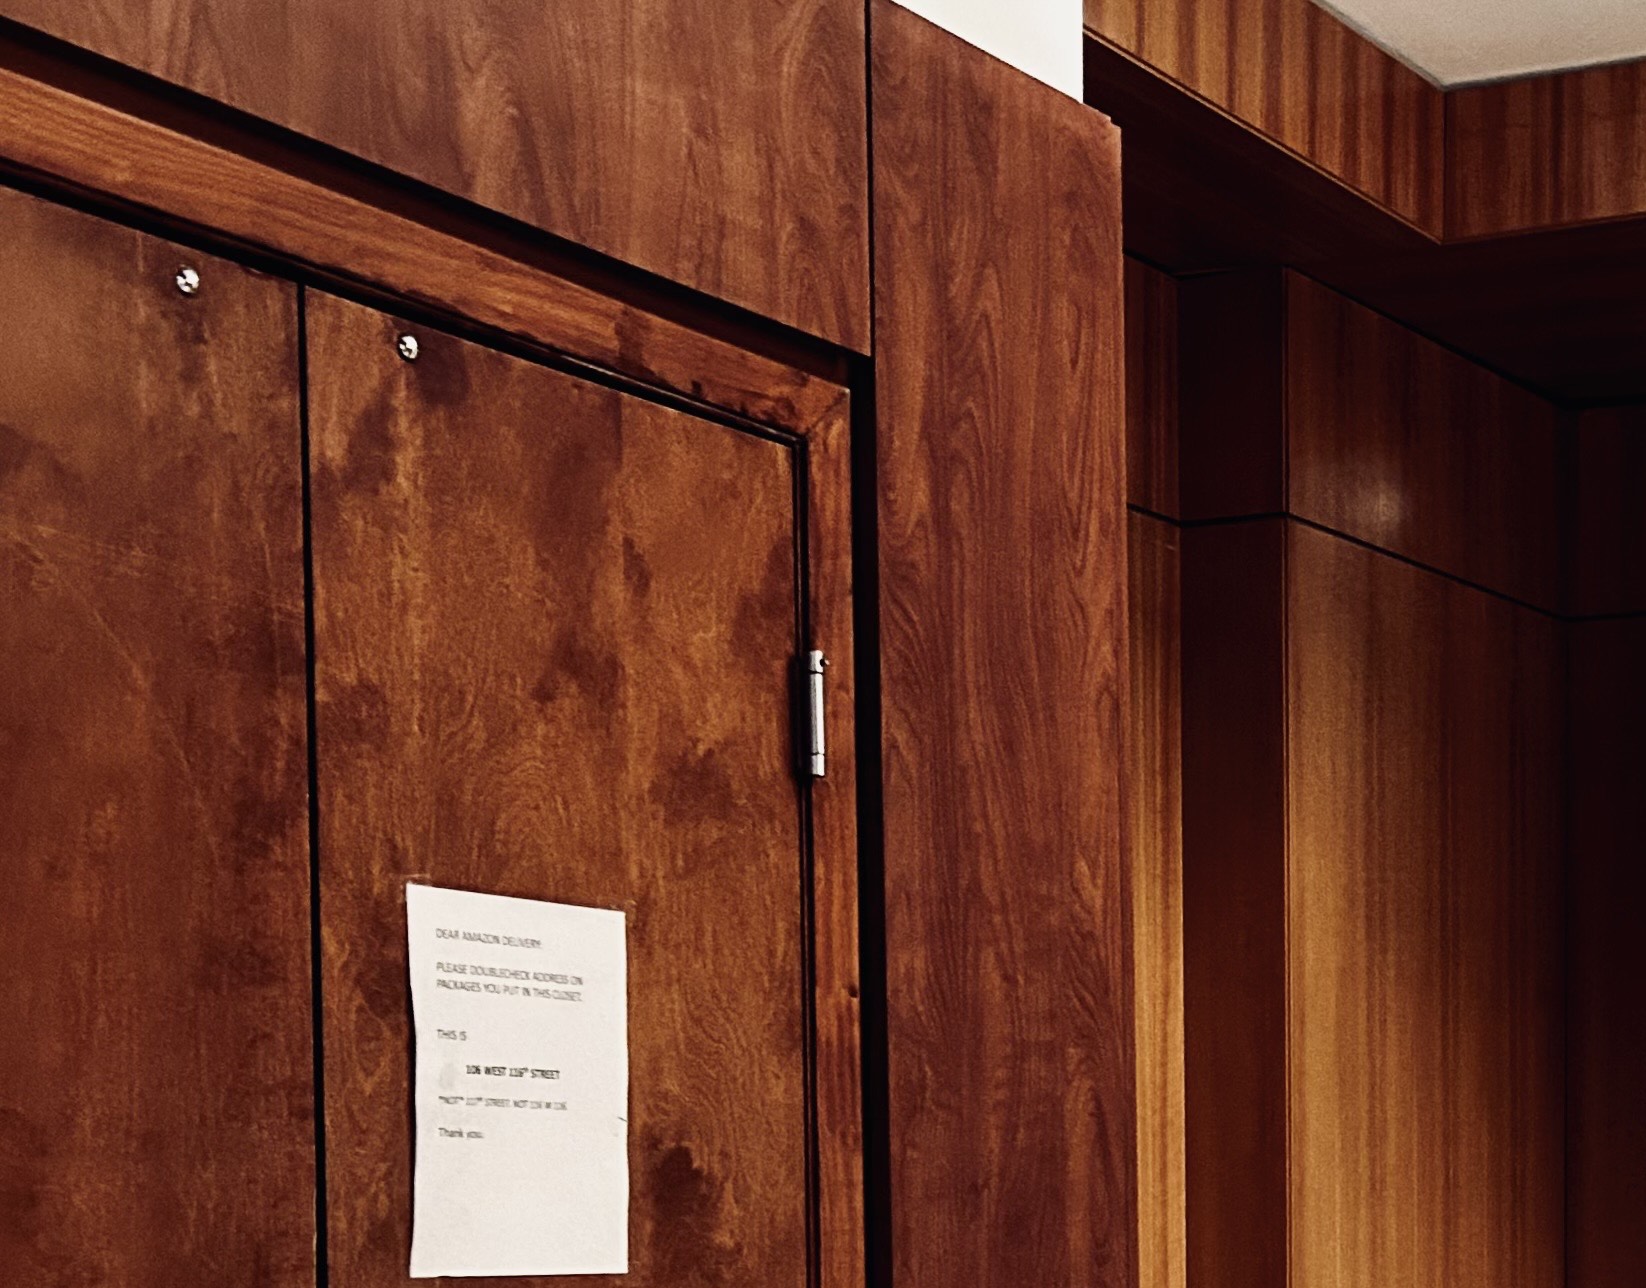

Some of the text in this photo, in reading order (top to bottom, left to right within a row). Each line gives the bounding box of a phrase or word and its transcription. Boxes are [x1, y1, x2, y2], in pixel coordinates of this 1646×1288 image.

[435, 928, 460, 939] DEAR
[462, 931, 500, 945] AMAZON
[436, 962, 584, 986] PLEASE DOUBLECHECK ADDRESS ON
[436, 979, 481, 993] PACKAGES
[484, 983, 501, 995] YOU
[503, 985, 520, 996] PUT
[522, 986, 531, 997] IN
[533, 988, 551, 999] THIS
[437, 1028, 467, 1041] THIS IS
[484, 1066, 507, 1077] WEST
[530, 1068, 560, 1080] STREET
[513, 1099, 529, 1109] NOT
[438, 1127, 463, 1138] Thank
